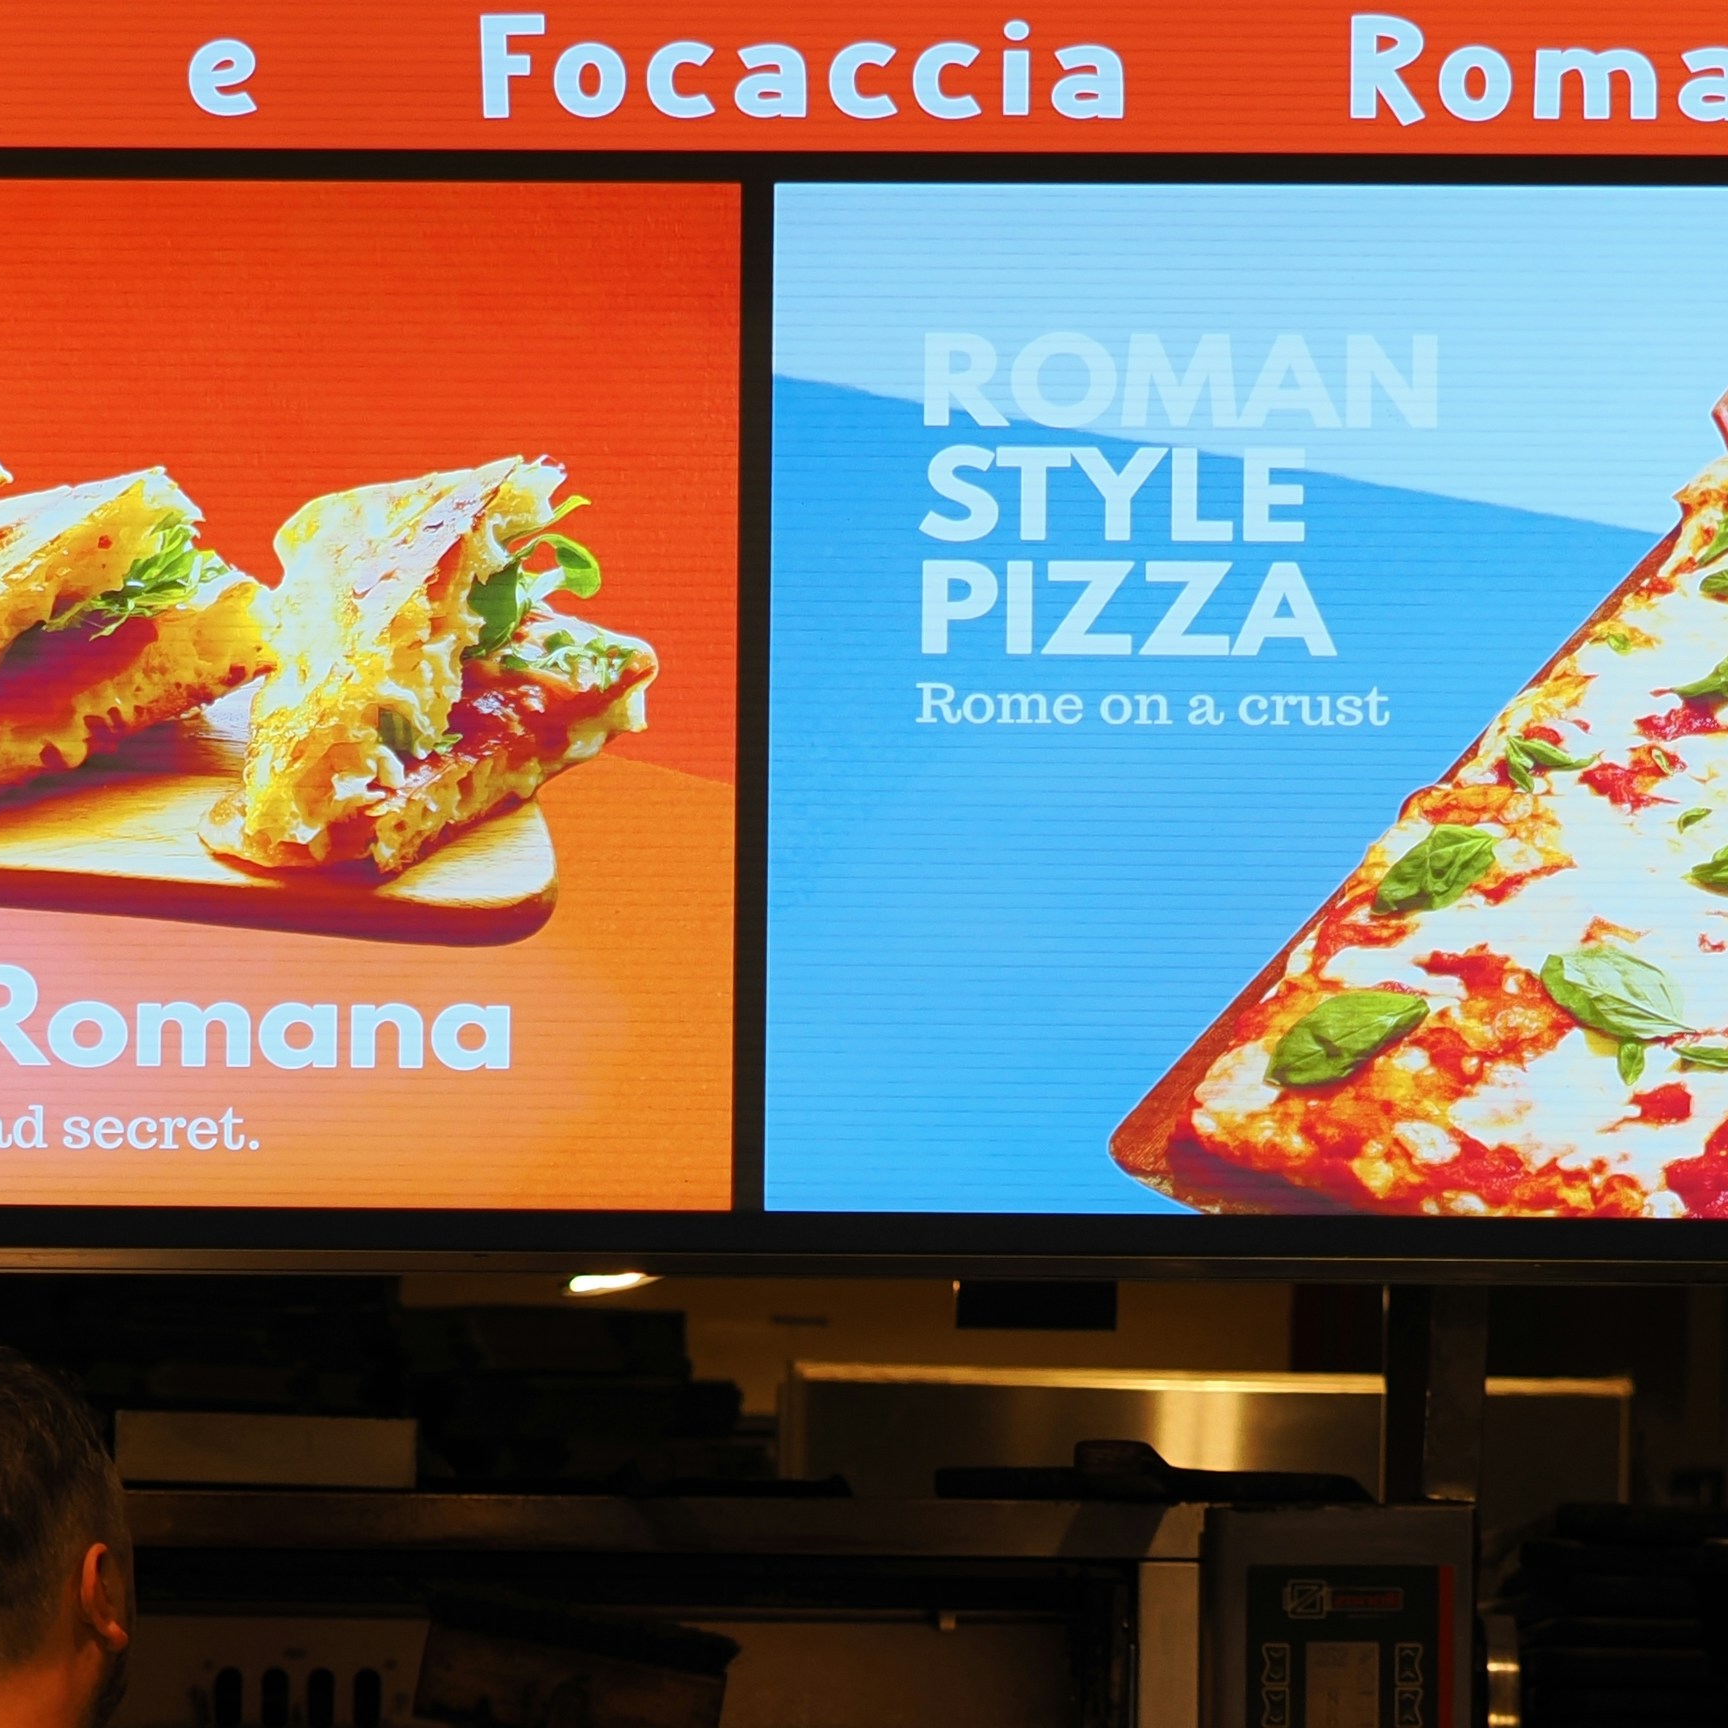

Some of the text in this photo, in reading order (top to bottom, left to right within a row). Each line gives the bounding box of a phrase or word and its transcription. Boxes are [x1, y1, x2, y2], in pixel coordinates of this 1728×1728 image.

[187, 38, 258, 117] e
[477, 13, 1126, 121] Focaccia
[923, 330, 1439, 429] ROMAN
[918, 443, 1306, 542] STYLE
[921, 560, 1339, 657] PIZZA
[915, 682, 1390, 728] Rome on a crust
[62, 1106, 260, 1151] secret.
